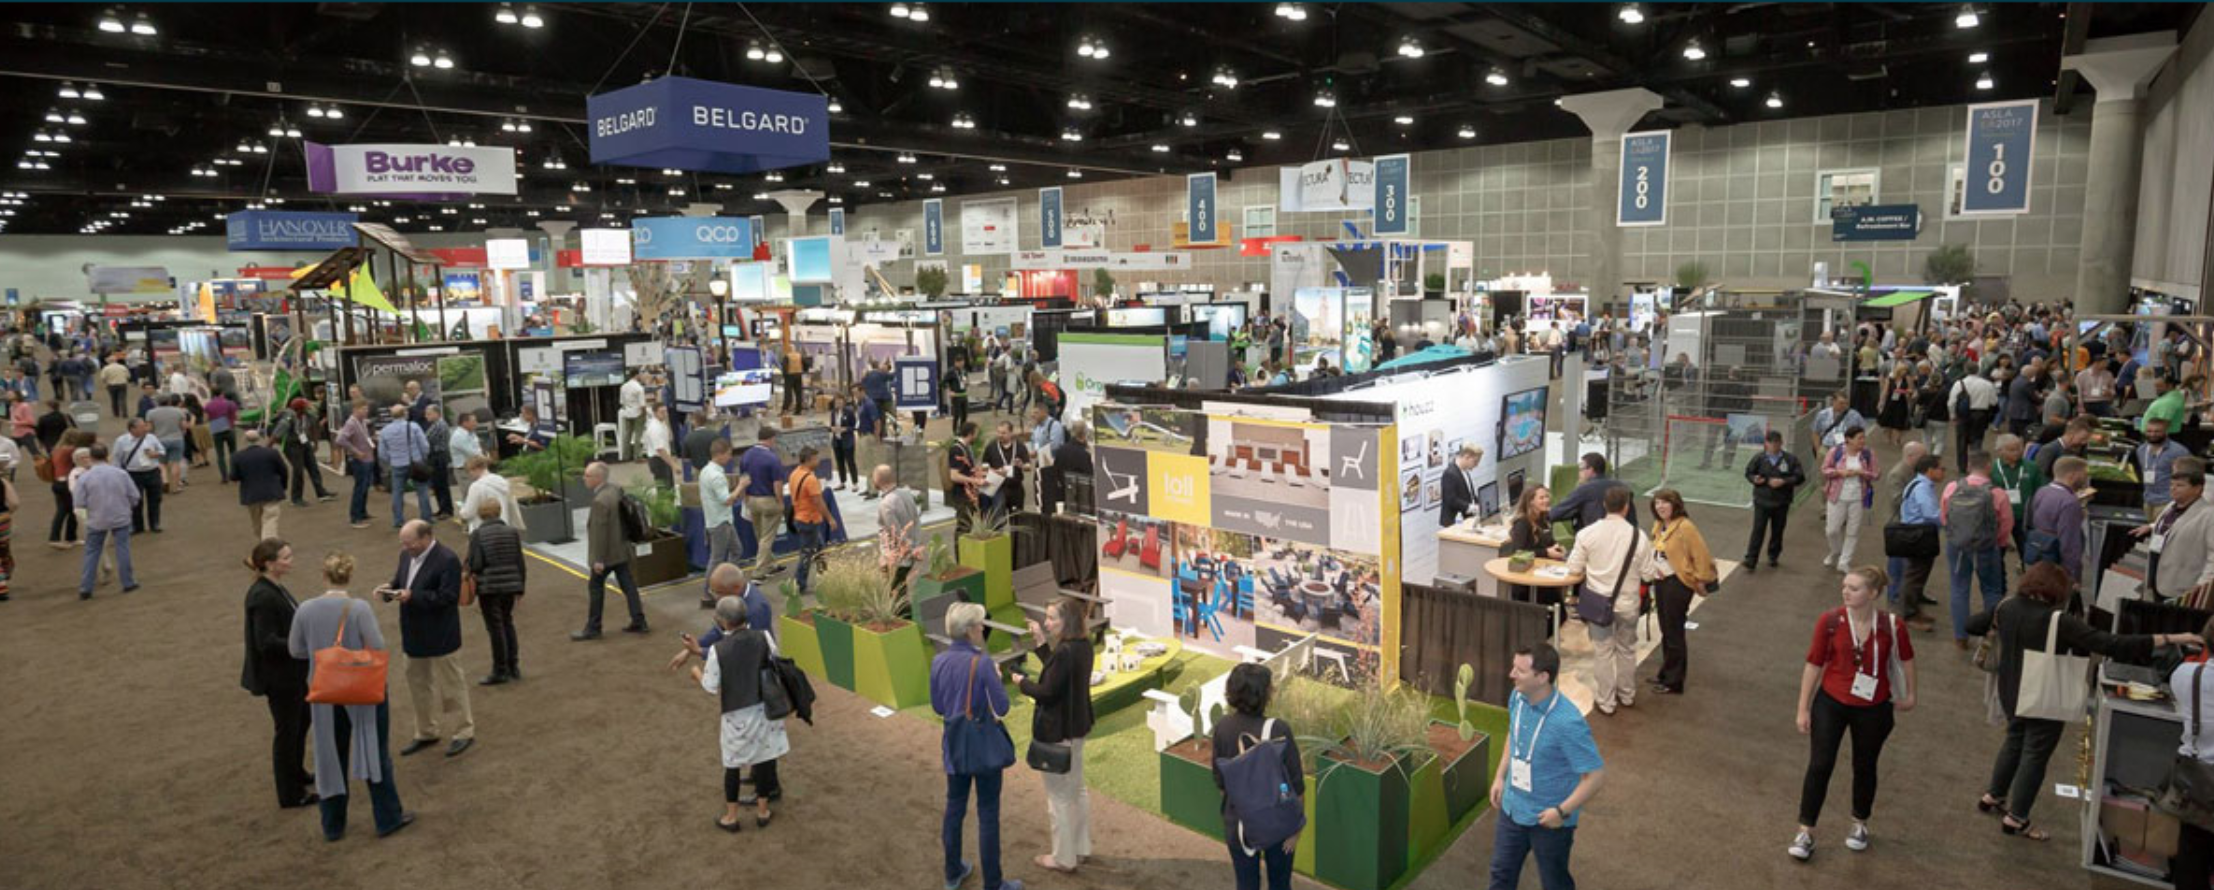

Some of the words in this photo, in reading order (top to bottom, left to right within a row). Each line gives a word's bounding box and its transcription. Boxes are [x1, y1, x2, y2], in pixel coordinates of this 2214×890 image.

[364, 151, 475, 174] Burke
[1988, 143, 2005, 194] 100
[392, 174, 415, 182] THAT
[1635, 166, 1648, 209] 200
[1197, 199, 1206, 232] 400
[1386, 184, 1395, 222] 300
[258, 219, 349, 236] HANOVER
[372, 360, 434, 375] permaloc
